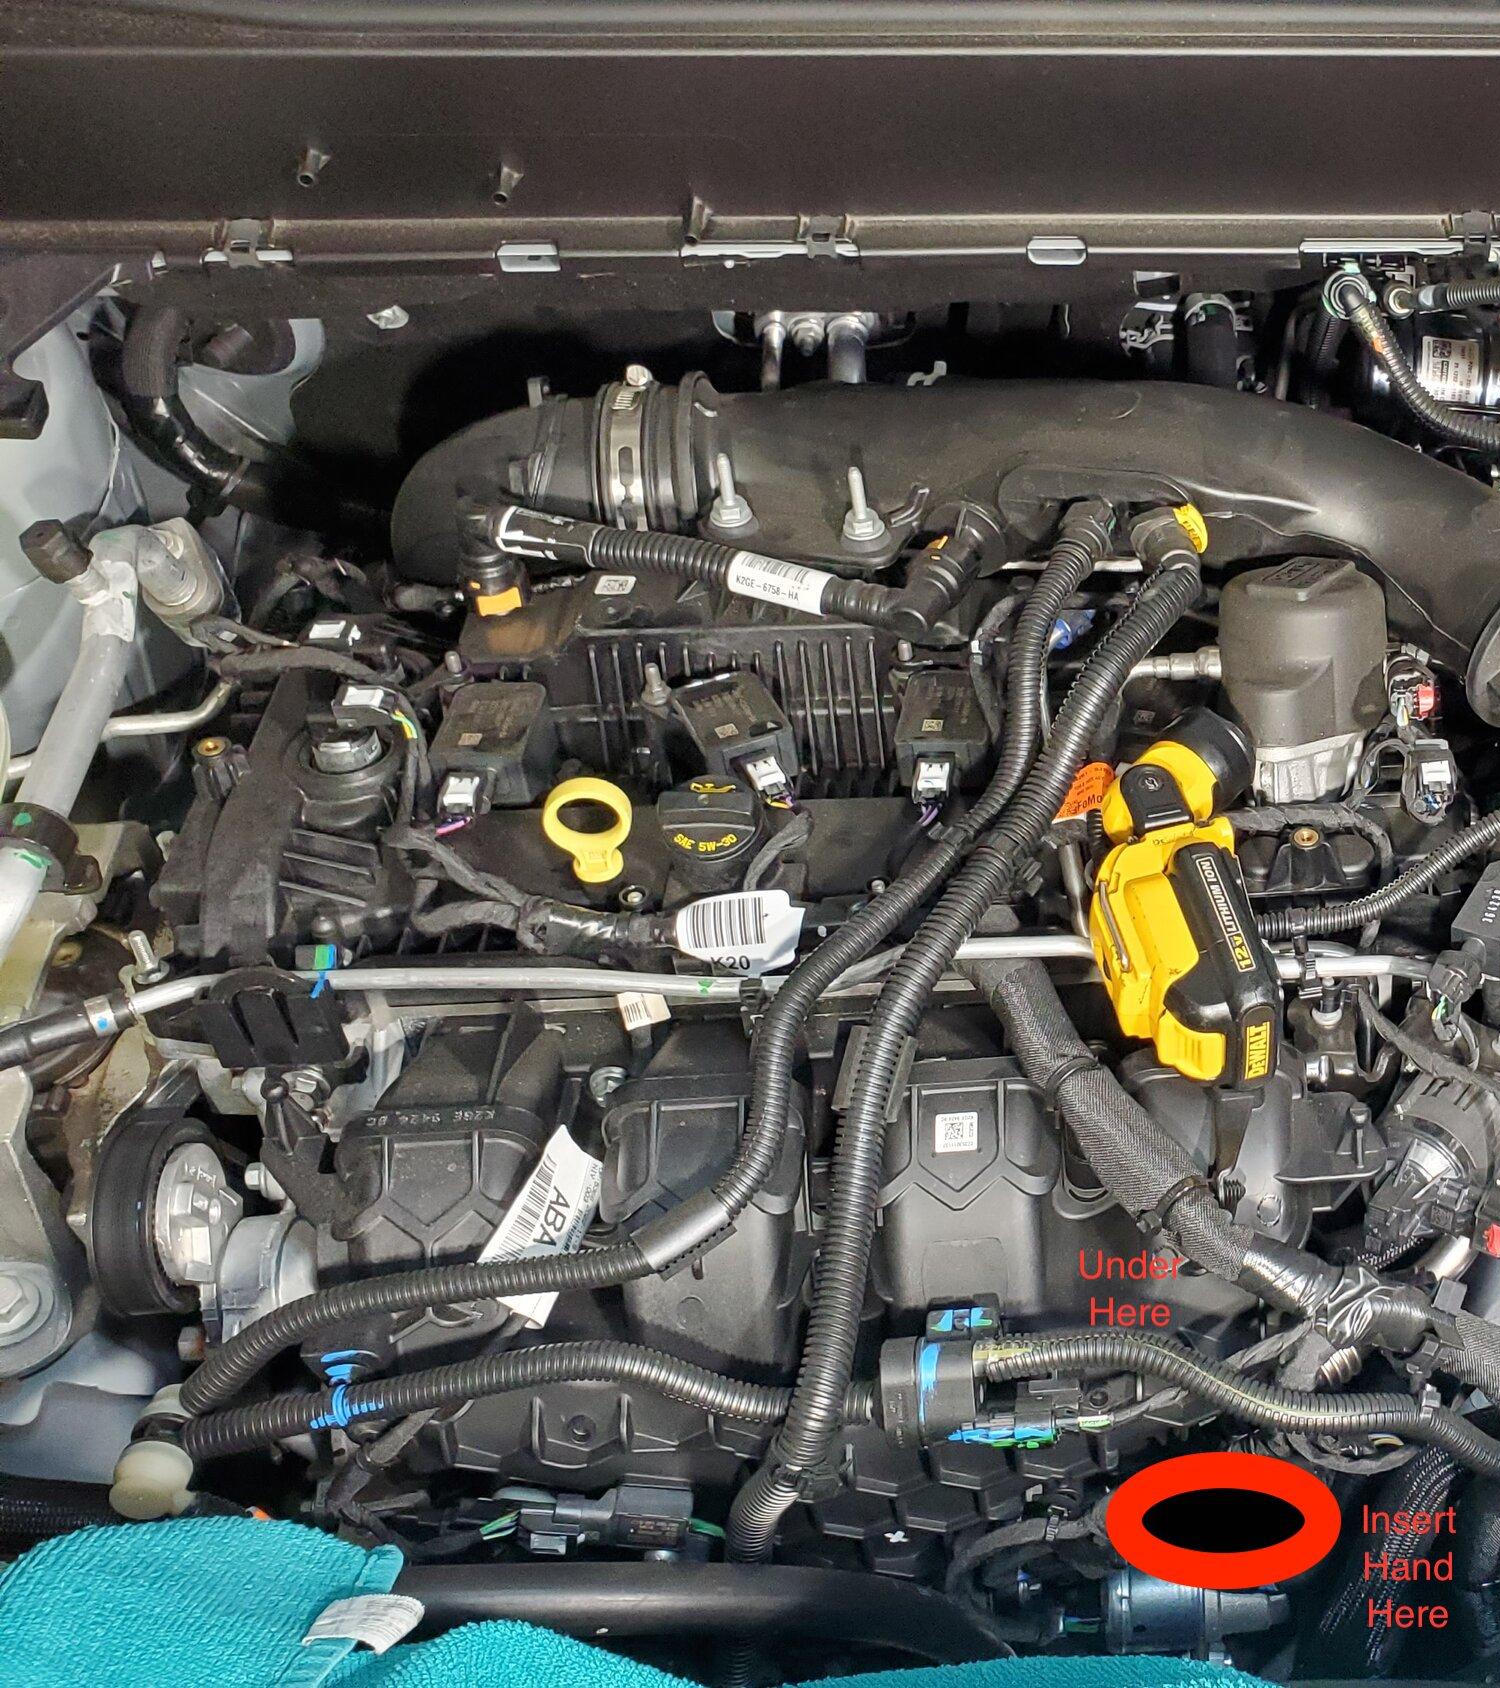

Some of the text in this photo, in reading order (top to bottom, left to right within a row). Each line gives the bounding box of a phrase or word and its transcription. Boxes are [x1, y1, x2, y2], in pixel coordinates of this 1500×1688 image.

[673, 833, 738, 852] SAE 5W-30
[1200, 861, 1252, 969] 12V LITHIUM ION
[710, 955, 751, 970] K20
[532, 1185, 571, 1247] ABA
